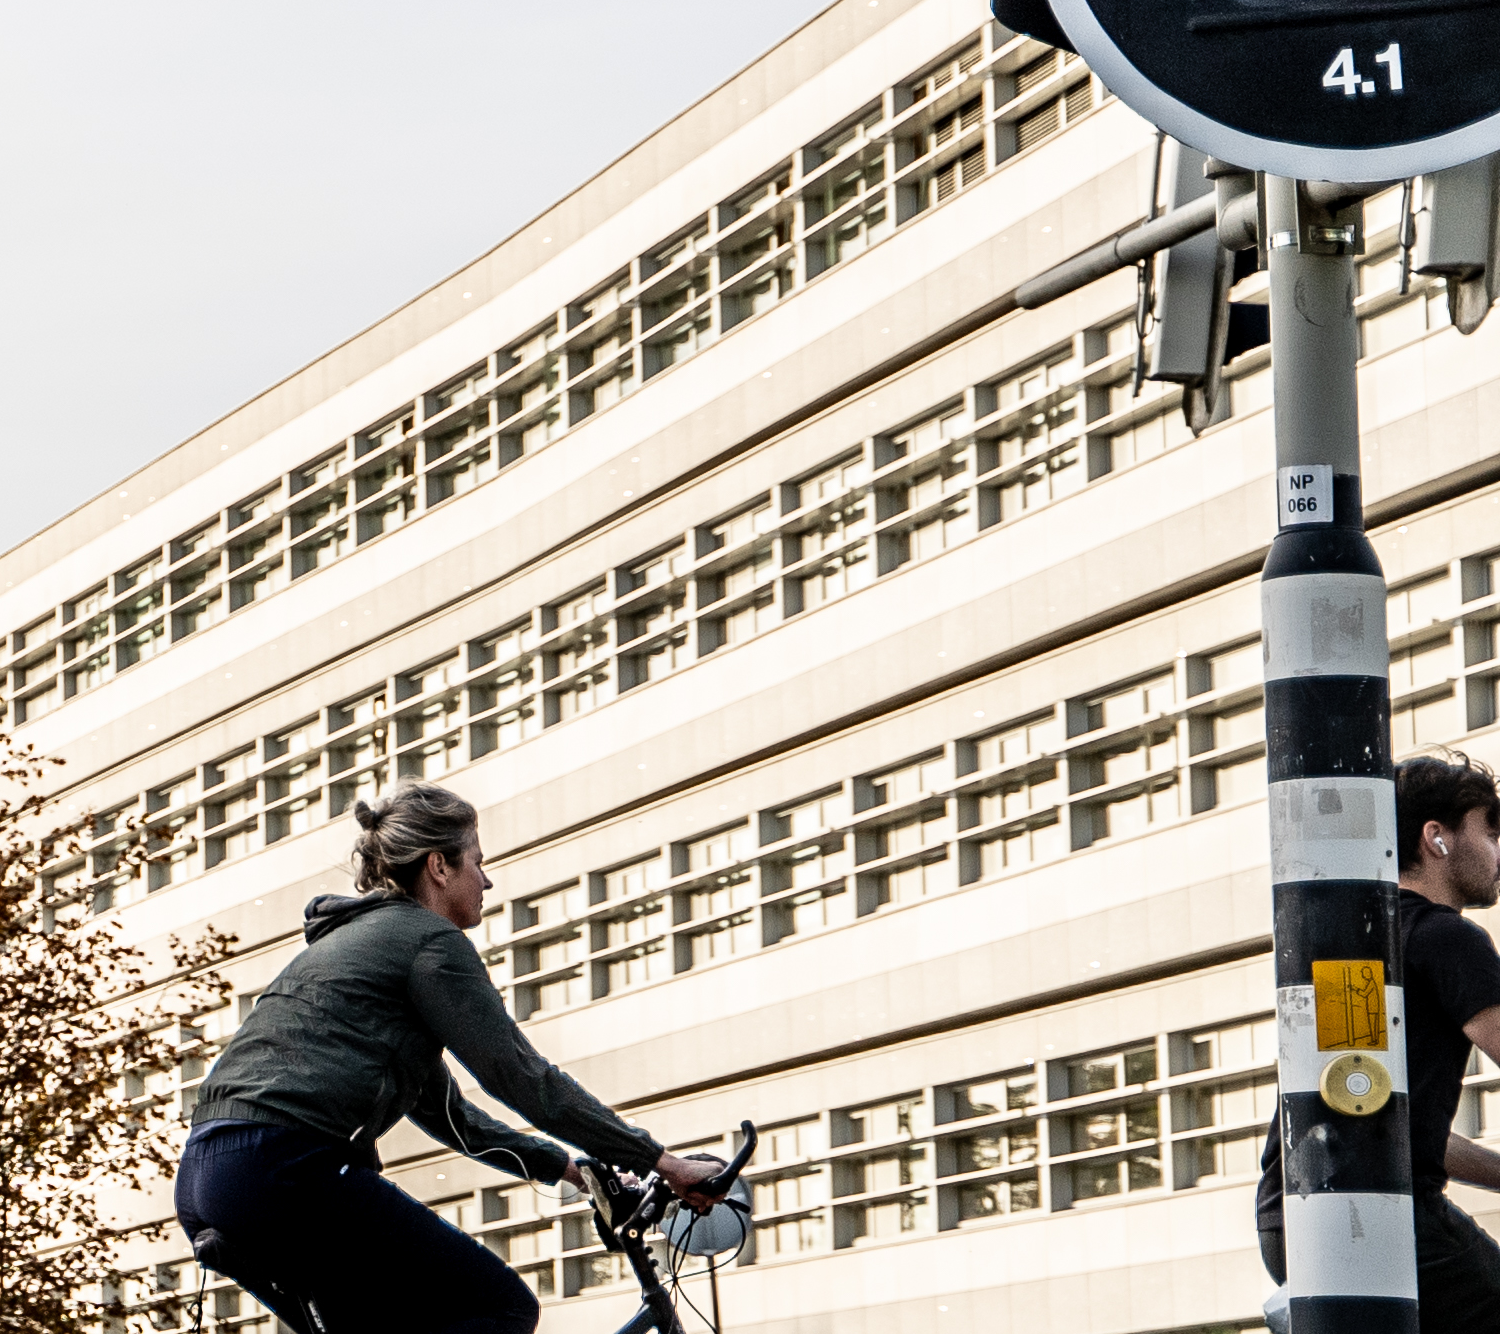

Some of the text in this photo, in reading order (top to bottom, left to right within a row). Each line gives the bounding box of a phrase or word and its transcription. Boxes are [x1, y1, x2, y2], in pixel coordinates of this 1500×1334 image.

[1321, 42, 1404, 96] 4.1
[1289, 474, 1315, 490] NP
[1288, 496, 1318, 514] 066
